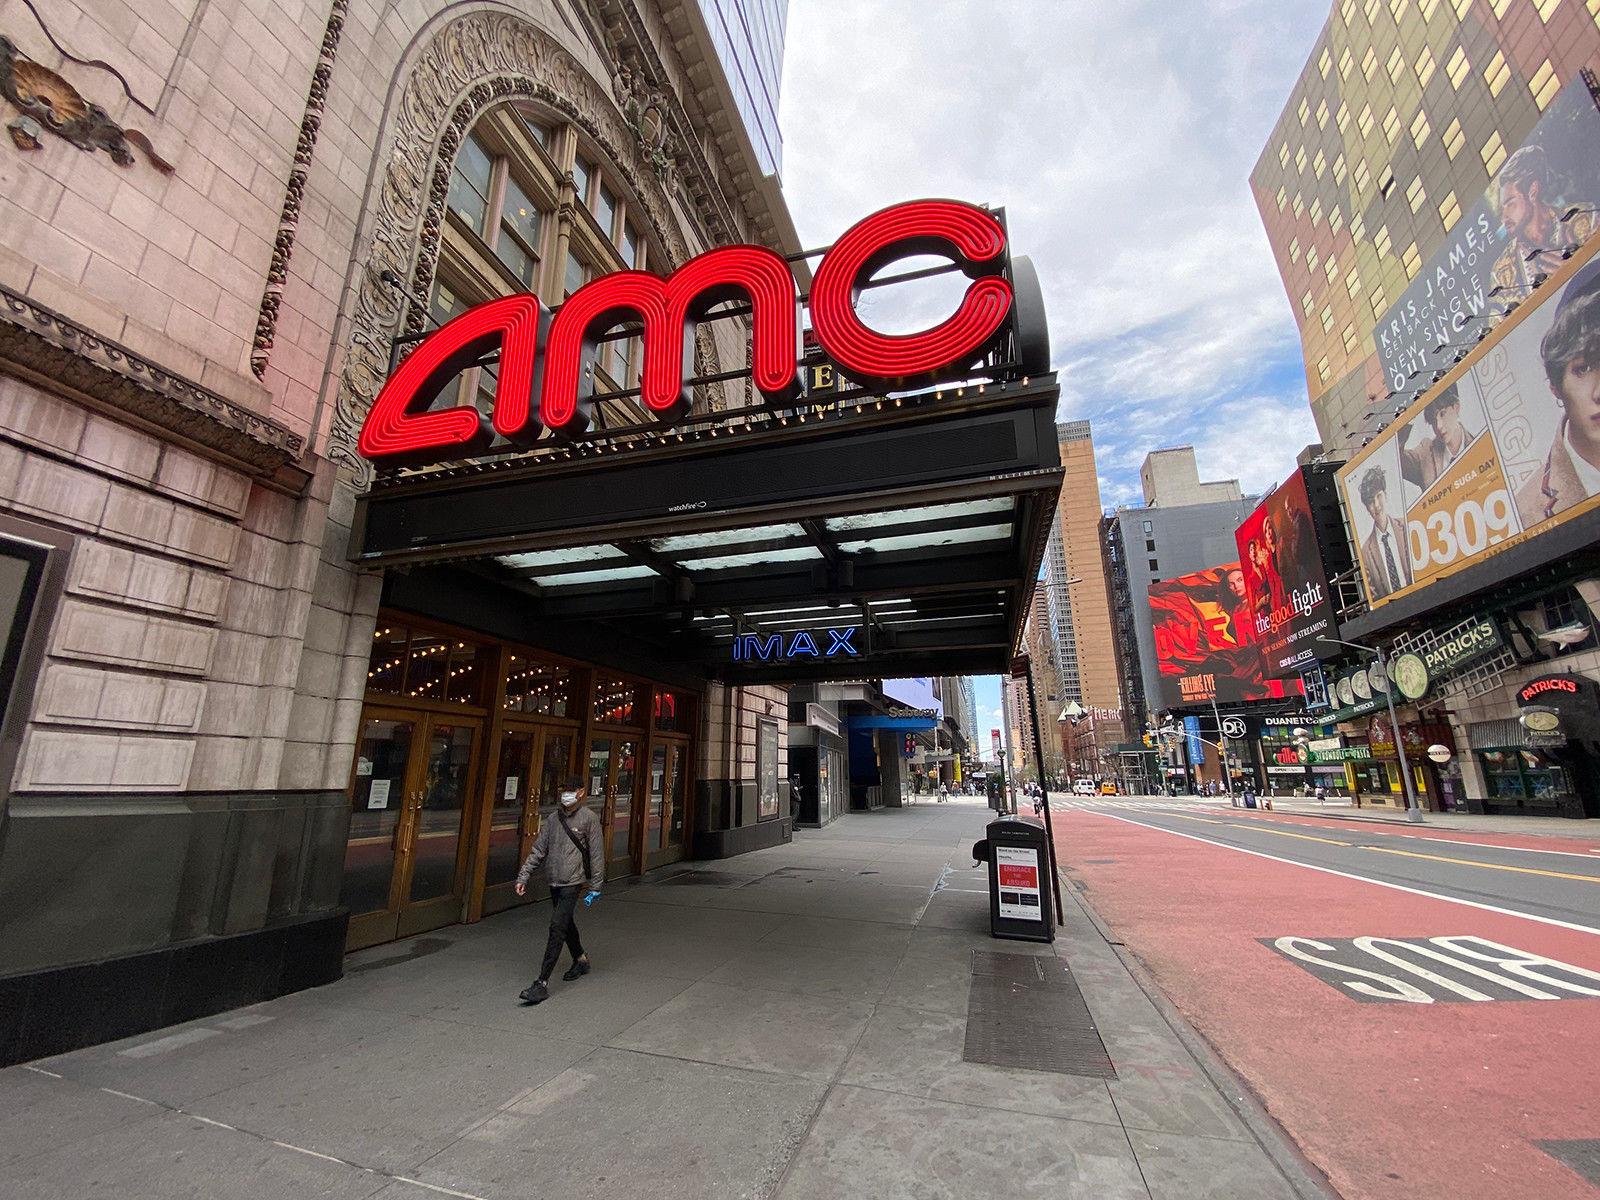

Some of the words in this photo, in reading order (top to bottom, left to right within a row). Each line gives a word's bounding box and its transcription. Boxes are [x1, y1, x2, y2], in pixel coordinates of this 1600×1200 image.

[1380, 301, 1416, 348] KRIS
[1427, 214, 1489, 297] JAMES
[1385, 335, 1404, 359] GET
[1408, 298, 1437, 335] BACK
[1440, 277, 1456, 297] TO
[1461, 231, 1495, 275] LOVE
[358, 199, 1014, 458] amc
[1389, 340, 1417, 378] NEW
[1424, 273, 1481, 342] SINGLE
[1394, 348, 1427, 391] OUT
[1436, 289, 1485, 346] NOW
[990, 467, 1057, 480] MULTIMEDIA
[1428, 484, 1453, 506] HAPPY
[1453, 470, 1478, 490] SUGA
[1478, 457, 1496, 474] DAY
[1410, 489, 1520, 571] 0309
[1256, 613, 1271, 633] the
[1270, 593, 1295, 633] good
[1292, 581, 1323, 616] fight
[1297, 619, 1328, 639] STREAMING
[733, 628, 857, 660] IMAX
[1425, 622, 1493, 668] PATRICK'S
[888, 706, 939, 719] Subway
[1522, 679, 1577, 700] PATRICK'S
[1265, 717, 1300, 725] DUANE
